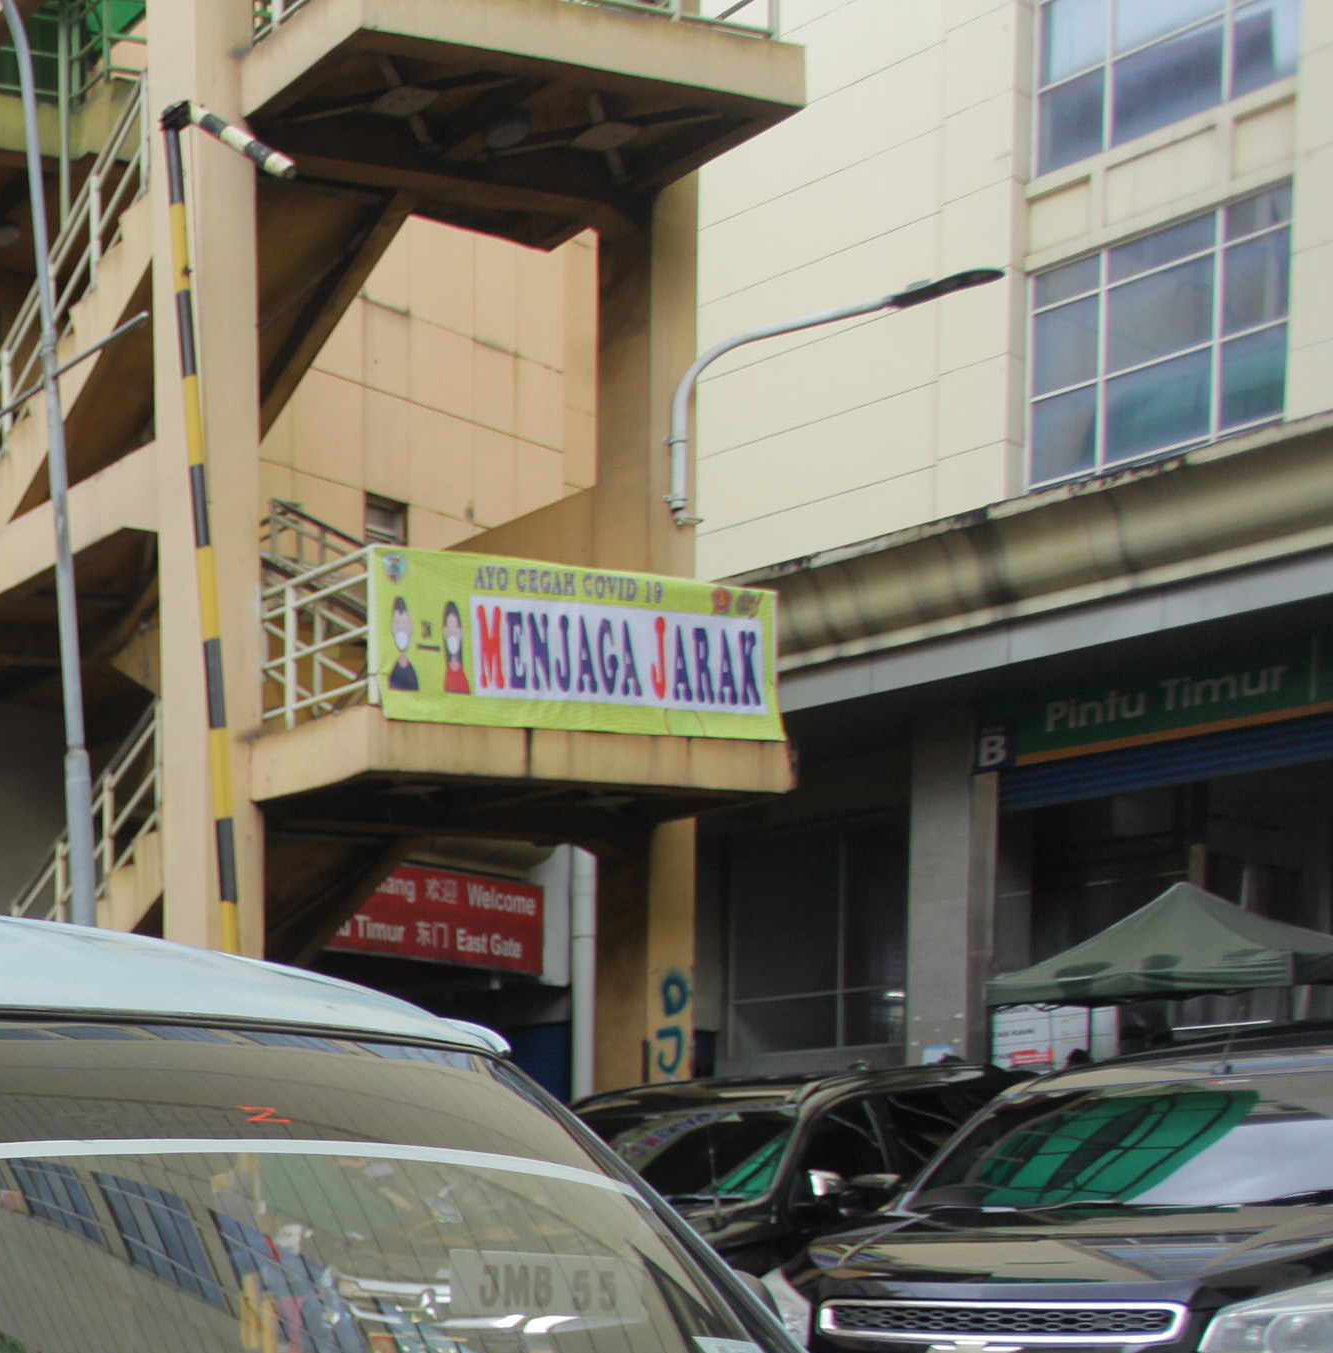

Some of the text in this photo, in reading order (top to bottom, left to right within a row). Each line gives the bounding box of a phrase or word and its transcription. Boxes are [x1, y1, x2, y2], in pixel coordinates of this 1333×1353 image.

[474, 565, 664, 604] AYO CEGAH COVID 19
[476, 604, 762, 707] MENJAGA JARAK
[1043, 664, 1289, 733] Pintu Timur
[424, 877, 459, 904] 欢迎
[466, 882, 537, 916] Welcome
[354, 914, 406, 944] Timur
[415, 921, 449, 949] 东门
[456, 928, 523, 959] East Gate
[478, 1264, 554, 1309] JMB
